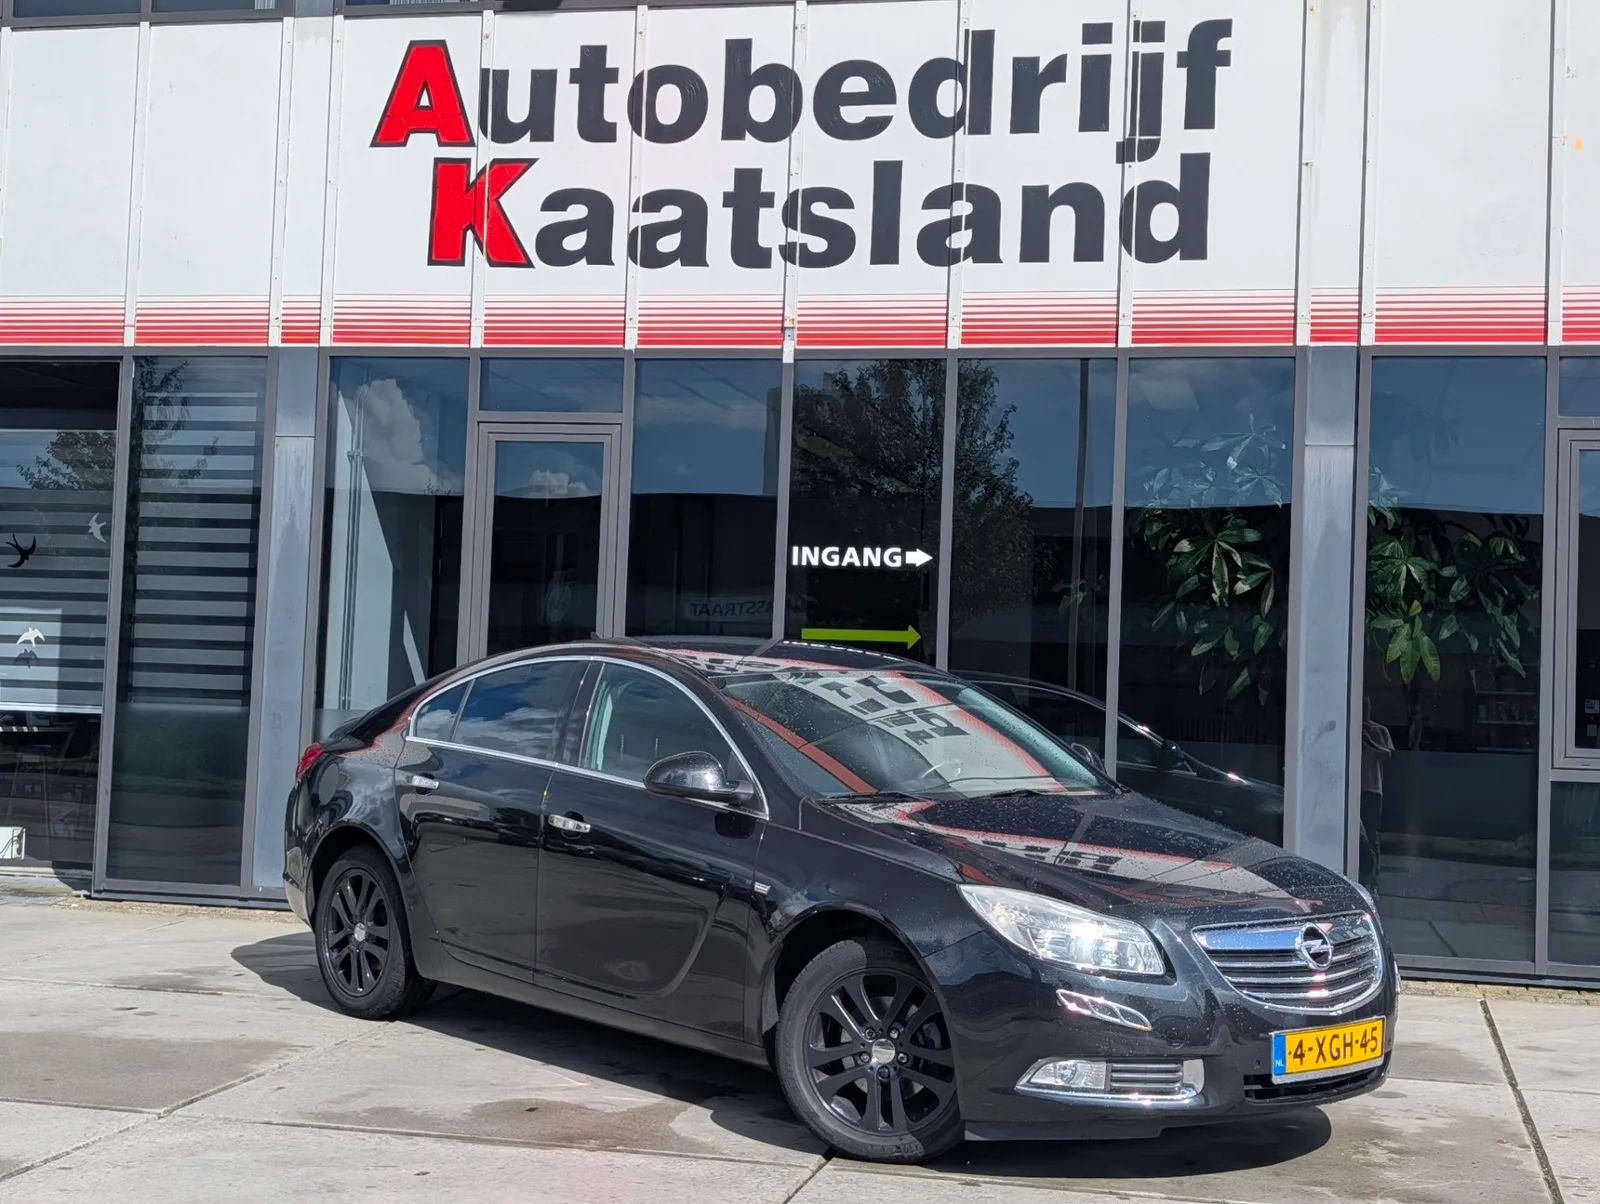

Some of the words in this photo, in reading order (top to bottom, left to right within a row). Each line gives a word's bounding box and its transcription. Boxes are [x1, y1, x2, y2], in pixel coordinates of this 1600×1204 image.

[370, 19, 1233, 165] Autobedrijf
[427, 152, 1211, 269] Kaatsland
[792, 546, 902, 568] INGANG
[1275, 1059, 1285, 1067] NL
[1292, 1026, 1379, 1066] 4-XGH-45
